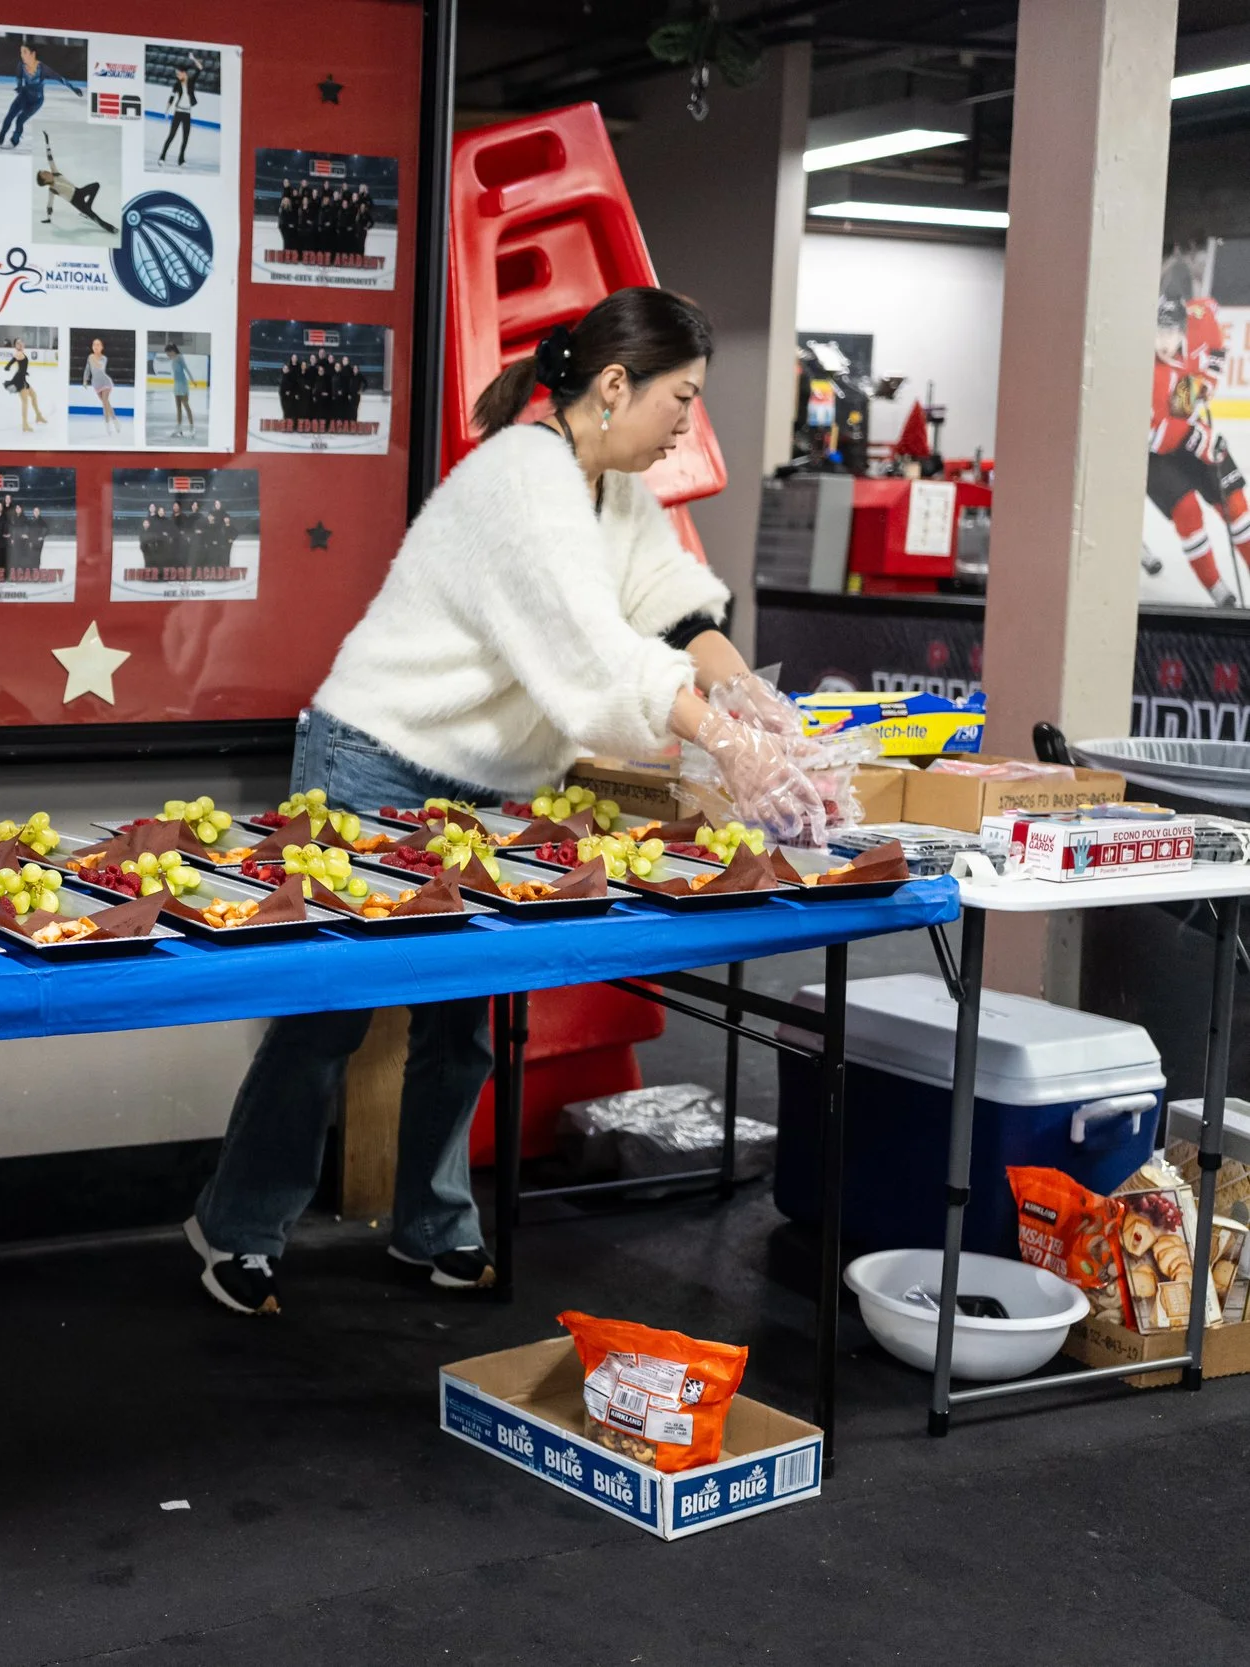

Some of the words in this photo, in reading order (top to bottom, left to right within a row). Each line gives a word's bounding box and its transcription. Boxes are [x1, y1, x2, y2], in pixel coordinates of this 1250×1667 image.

[45, 271, 108, 284] NATIONAL
[955, 726, 979, 741] 750
[1113, 831, 1140, 841] ECONO
[1142, 829, 1161, 840] POLY
[1163, 826, 1192, 837] GLOVES
[1029, 841, 1054, 852] GARDS
[1024, 1201, 1057, 1220] KIRKLAND
[610, 1410, 642, 1426] KIRKLAND
[497, 1424, 534, 1457] Blue
[544, 1446, 583, 1481] Blue
[593, 1470, 633, 1506] Blue
[729, 1478, 767, 1503] Blue
[681, 1491, 721, 1518] Blue
